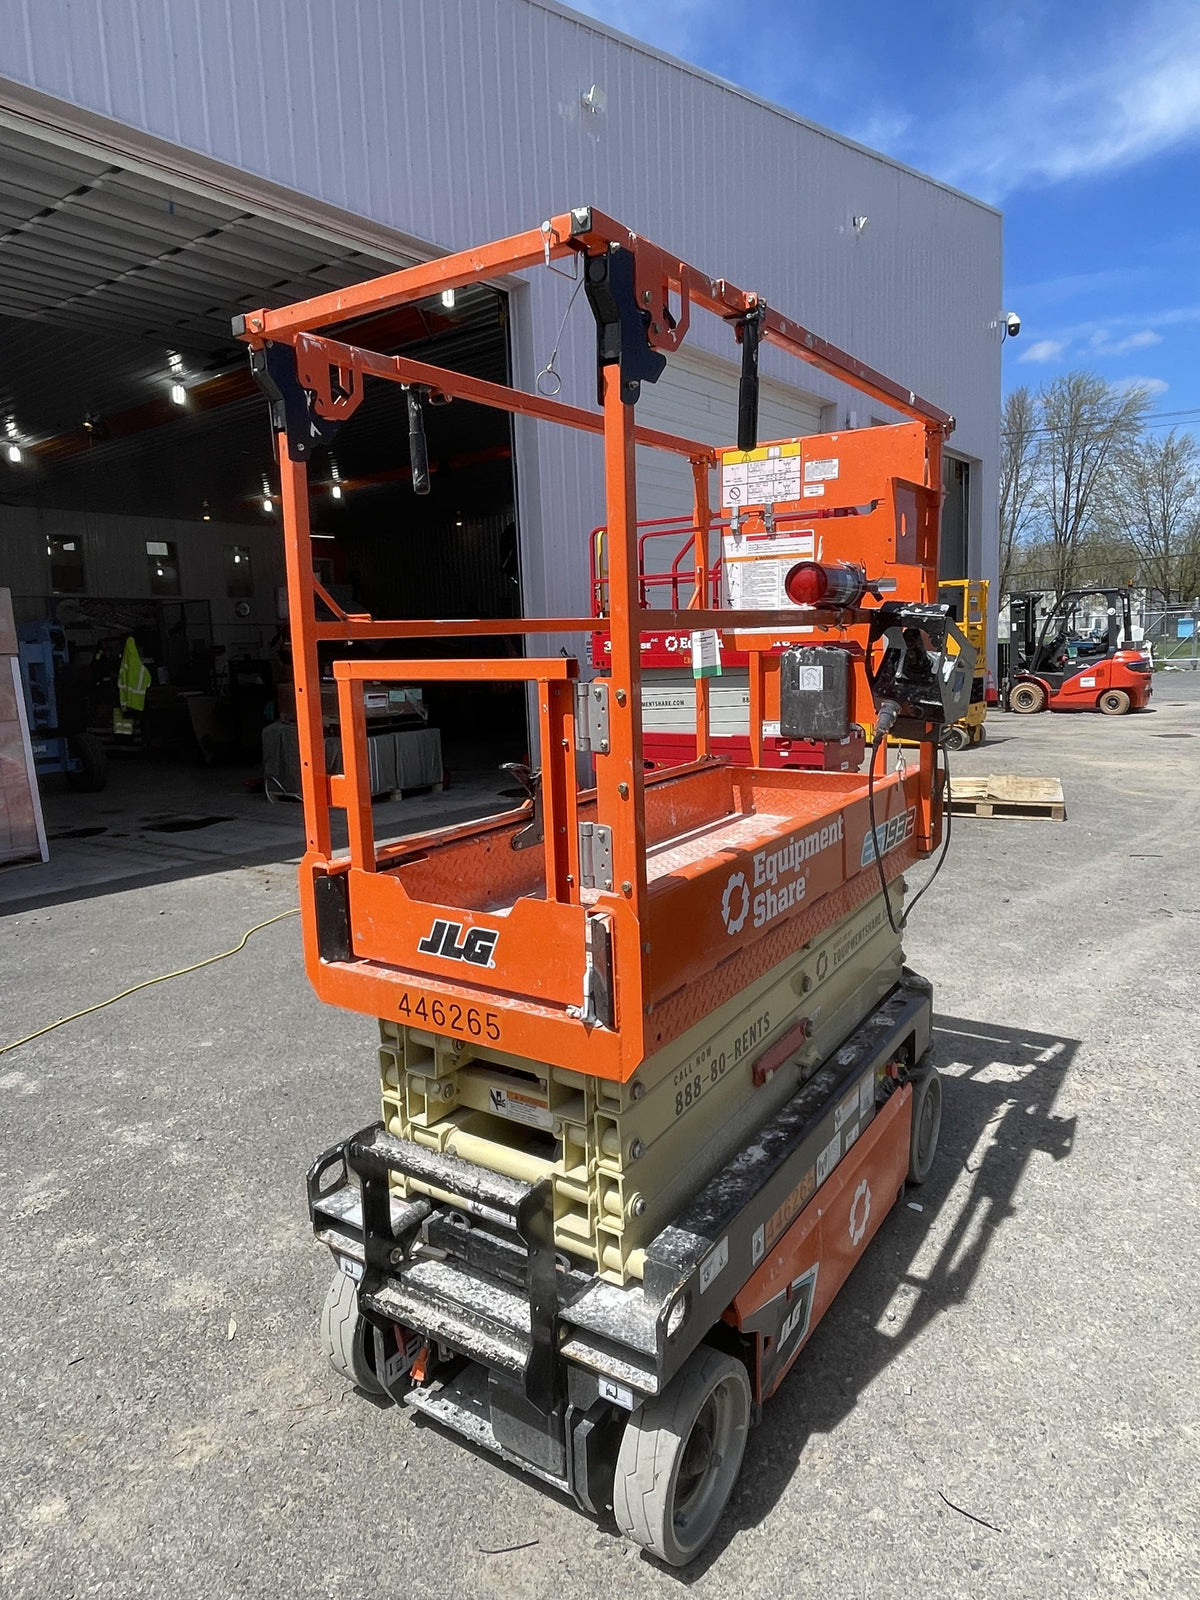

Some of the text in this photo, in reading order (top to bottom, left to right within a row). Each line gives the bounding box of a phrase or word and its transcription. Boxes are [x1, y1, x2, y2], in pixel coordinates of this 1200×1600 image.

[752, 814, 845, 888] Equipment
[752, 876, 806, 929] Share
[417, 918, 500, 969] JLG
[399, 992, 501, 1041] 446265
[673, 1045, 713, 1087] CALL NOW
[674, 1011, 771, 1116] 888-80-RENTS
